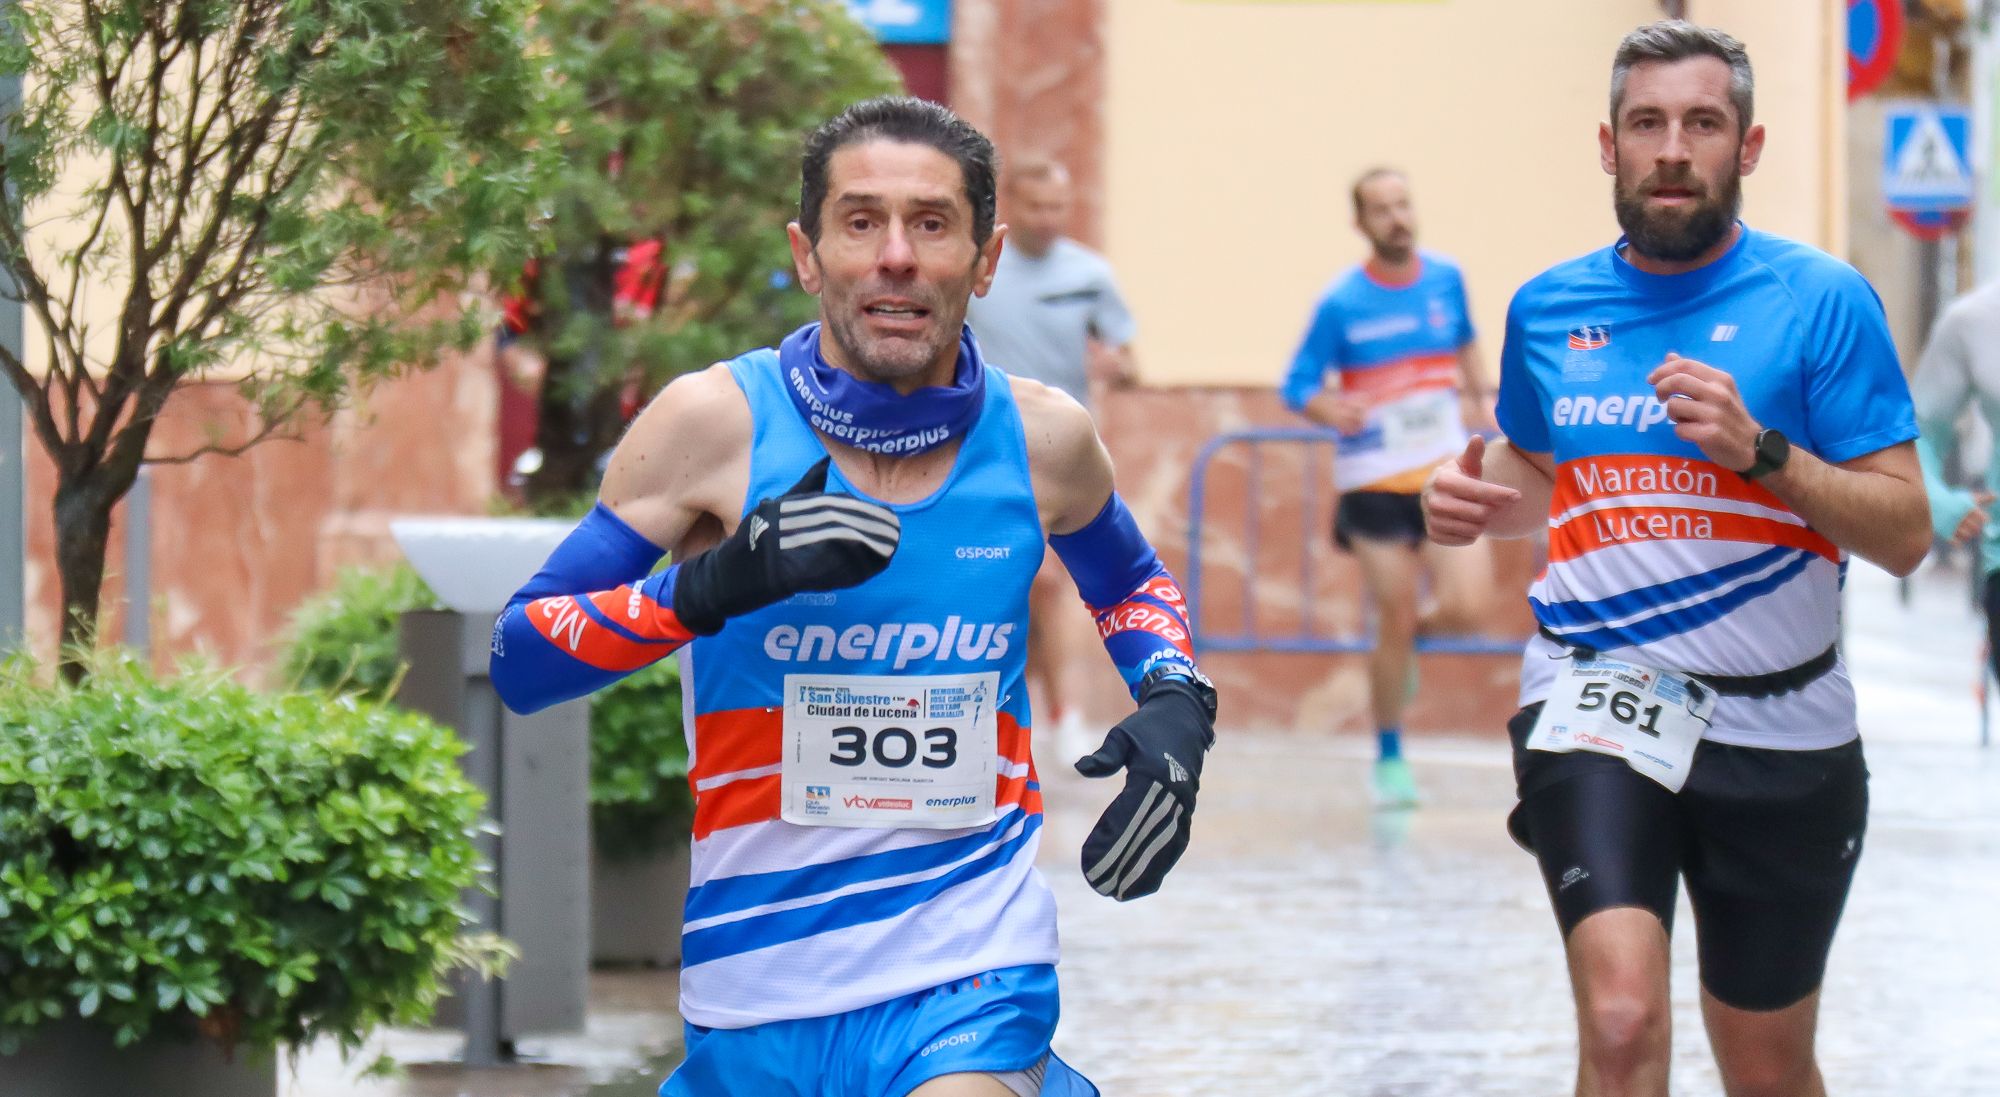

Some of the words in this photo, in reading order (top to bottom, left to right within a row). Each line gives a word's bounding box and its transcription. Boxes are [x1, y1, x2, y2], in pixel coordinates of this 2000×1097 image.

[789, 366, 855, 425] enerplus
[810, 414, 905, 443] enerplu
[1553, 396, 1678, 433] enerp
[1573, 461, 1718, 496] Maratón
[1593, 513, 1714, 543] Lucena
[955, 546, 1010, 559] GSPORT
[538, 596, 588, 652] Ma
[763, 614, 1015, 670] enerplus
[807, 704, 851, 717] Ciudad
[854, 706, 869, 717] de
[873, 707, 917, 719] Lucena
[808, 690, 832, 704] San
[835, 690, 891, 705] Silvestre
[1576, 682, 1663, 739] 561
[829, 726, 958, 769] 303
[926, 796, 977, 807] enerplus
[921, 1031, 978, 1057] GSPORT
